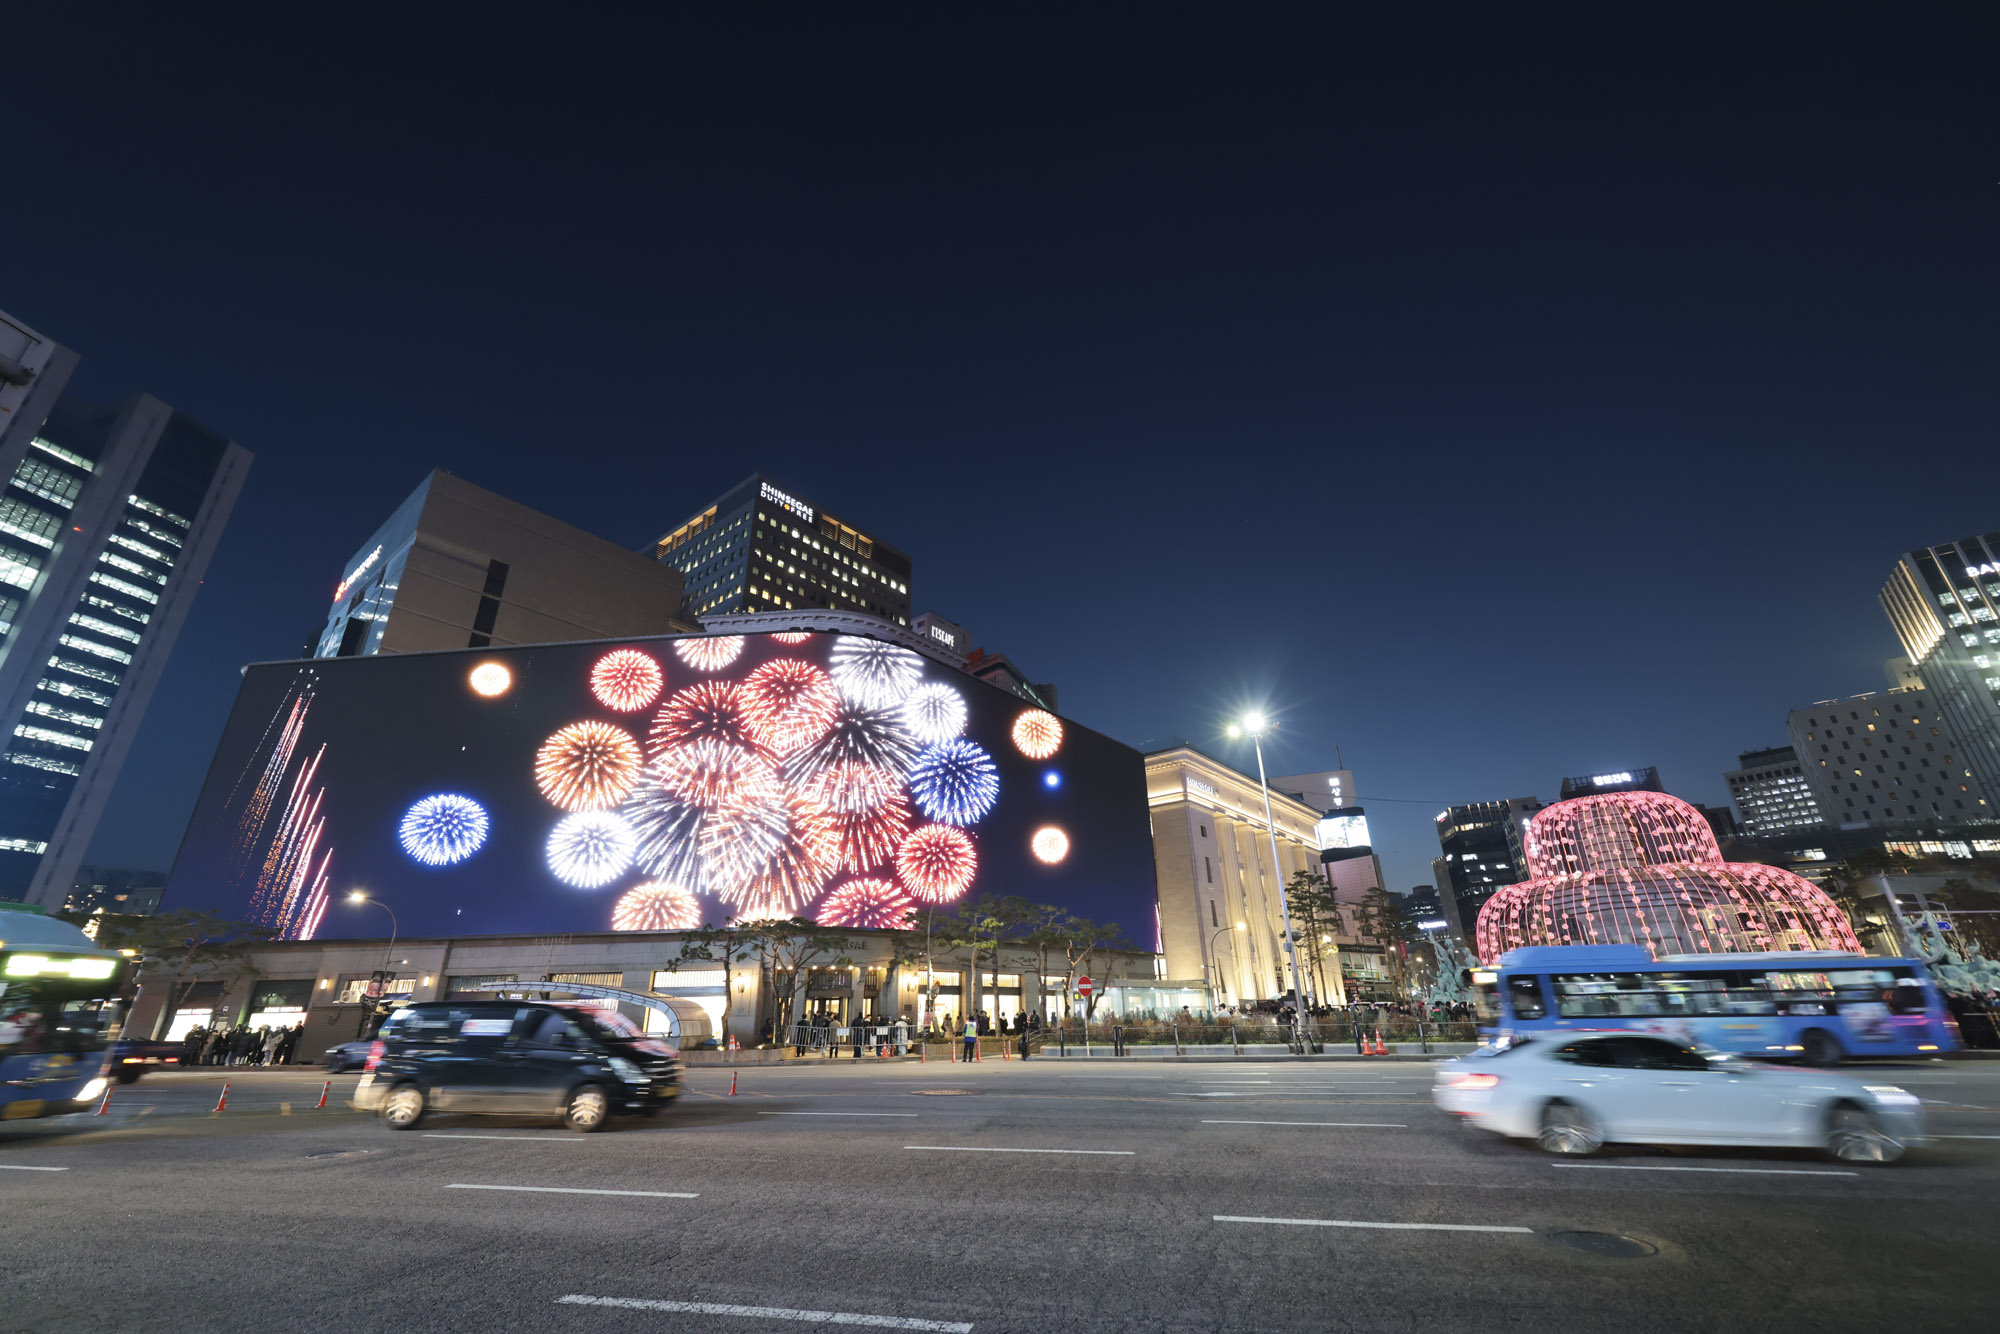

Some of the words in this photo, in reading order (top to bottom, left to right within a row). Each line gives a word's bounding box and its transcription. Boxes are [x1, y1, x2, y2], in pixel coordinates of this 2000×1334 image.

[760, 490, 785, 507] DUTY
[790, 506, 813, 524] FREE
[761, 482, 814, 517] SHINSEGAE
